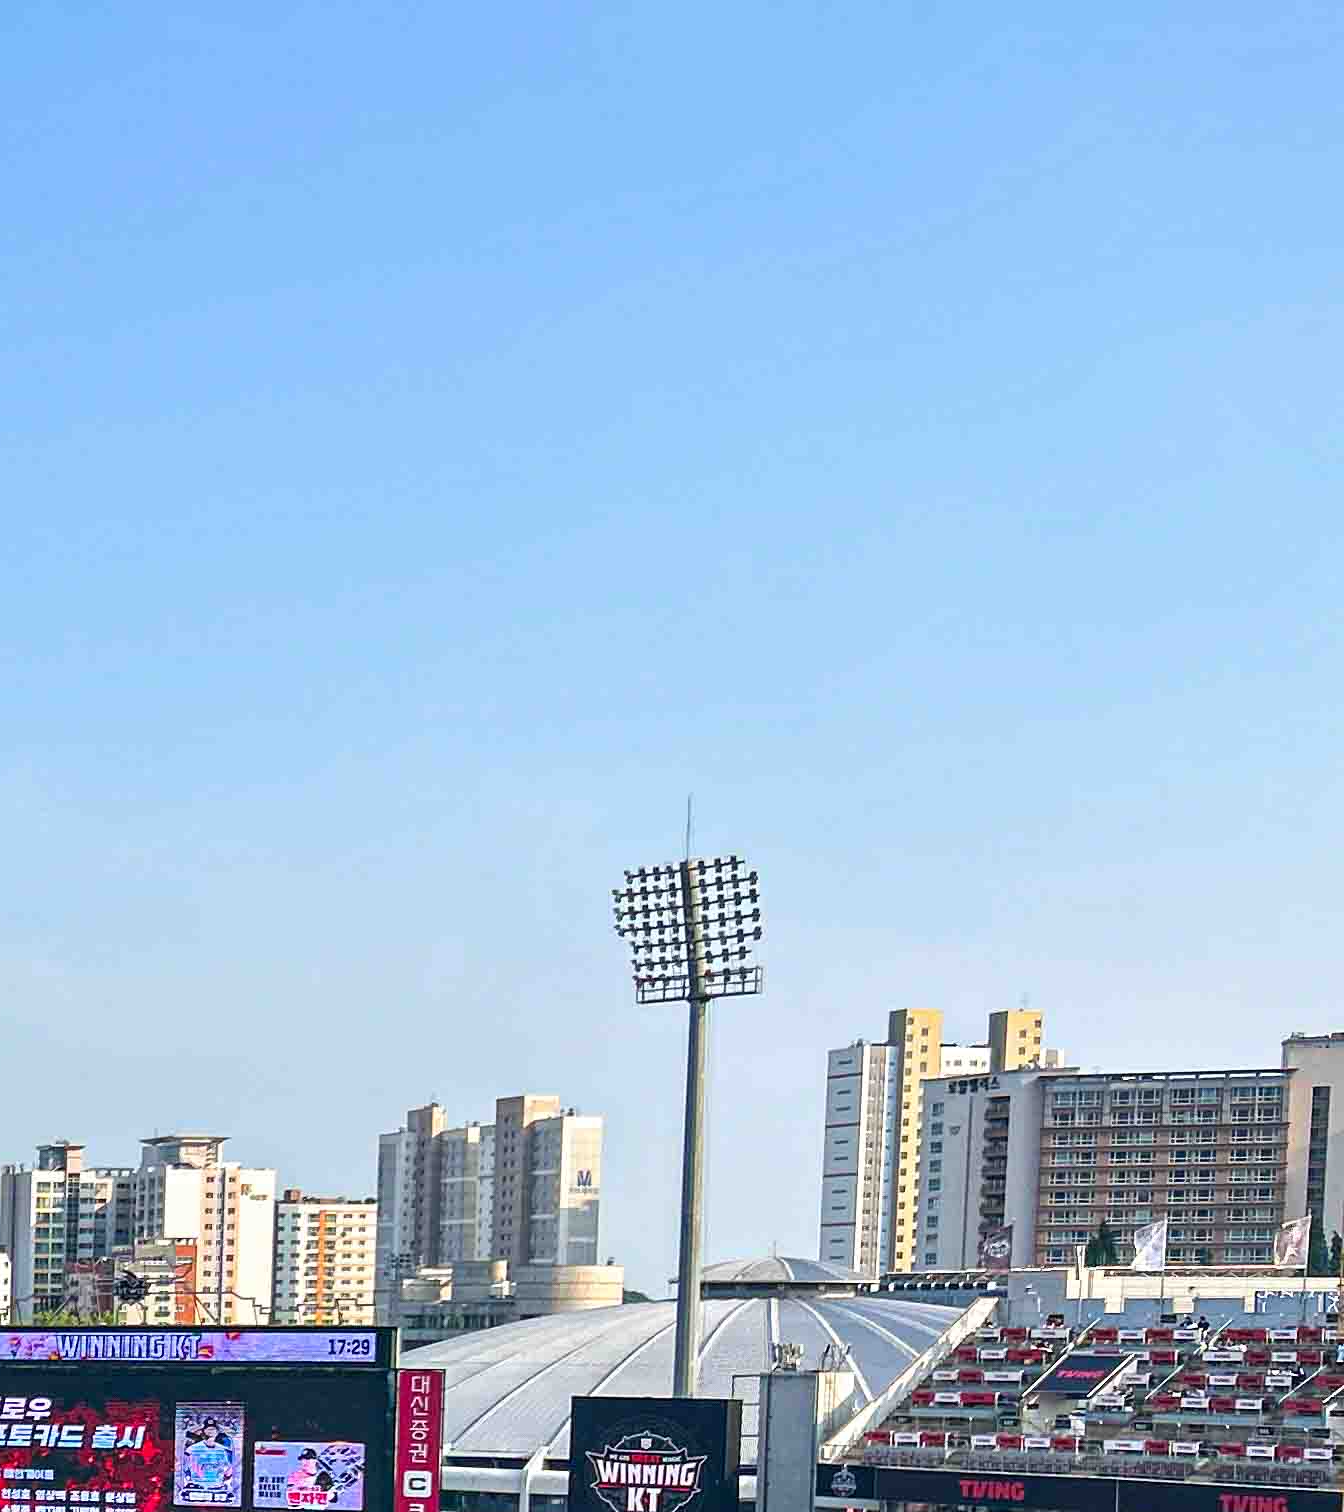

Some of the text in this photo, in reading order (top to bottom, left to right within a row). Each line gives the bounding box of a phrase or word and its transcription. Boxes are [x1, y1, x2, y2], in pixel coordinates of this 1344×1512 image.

[327, 1338, 371, 1356] 17:29
[409, 1376, 431, 1464] 대신증권
[92, 1425, 146, 1449] 출시
[595, 1459, 697, 1487] WINNING
[626, 1487, 661, 1512] KT
[959, 1479, 1025, 1501] TVING
